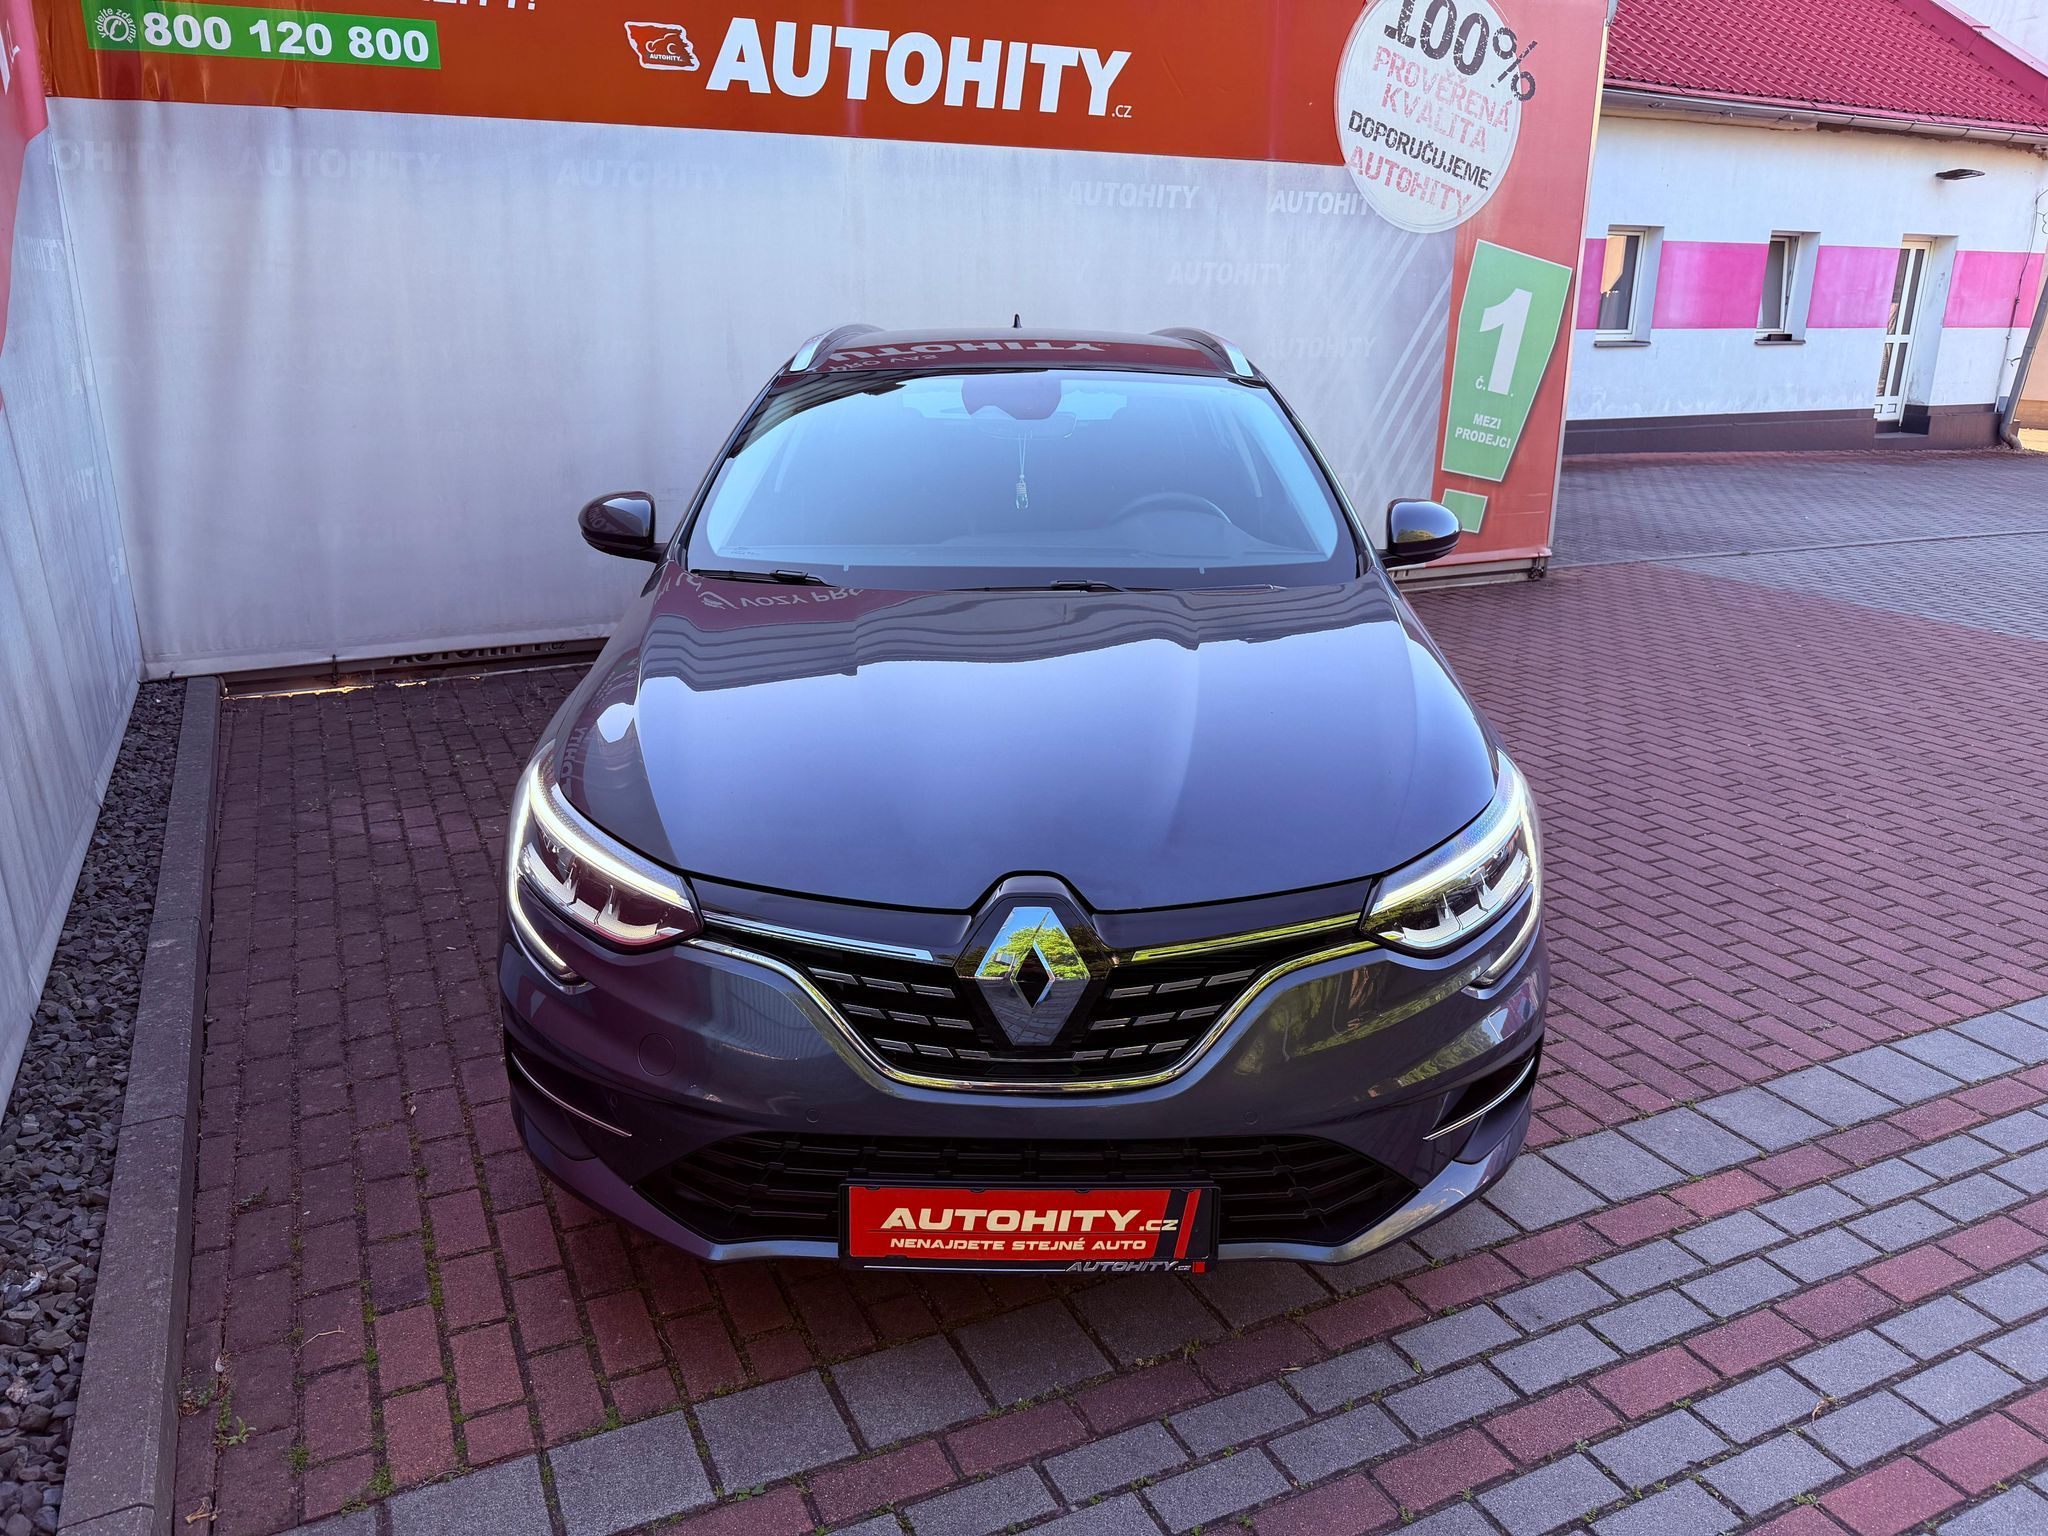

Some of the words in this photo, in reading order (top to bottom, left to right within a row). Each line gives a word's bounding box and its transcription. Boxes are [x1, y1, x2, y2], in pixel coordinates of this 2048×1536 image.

[115, 9, 137, 44] zdarma
[143, 12, 232, 51] 800
[249, 19, 333, 57] 120
[348, 25, 429, 62] 800
[1384, 0, 1538, 102] 100%
[1372, 45, 1513, 132] PROVĚŘENÁ
[1381, 83, 1486, 153] KVALITA
[1348, 110, 1492, 191] DOPORUČUJEME
[1069, 180, 1200, 210] AUTOHITY
[1350, 146, 1473, 217] AUTOHITY
[1269, 189, 1379, 216] AUTOHIT
[1167, 261, 1290, 286] AUTOHITY
[1455, 426, 1512, 449] PRODEJCI
[1472, 413, 1502, 430] MEZI
[880, 1207, 1179, 1232] AUTOHITY.cz
[890, 1238, 1006, 1251] NENAJDETE
[1011, 1236, 1086, 1251] STEJNÉ
[1091, 1239, 1147, 1251] AUTO
